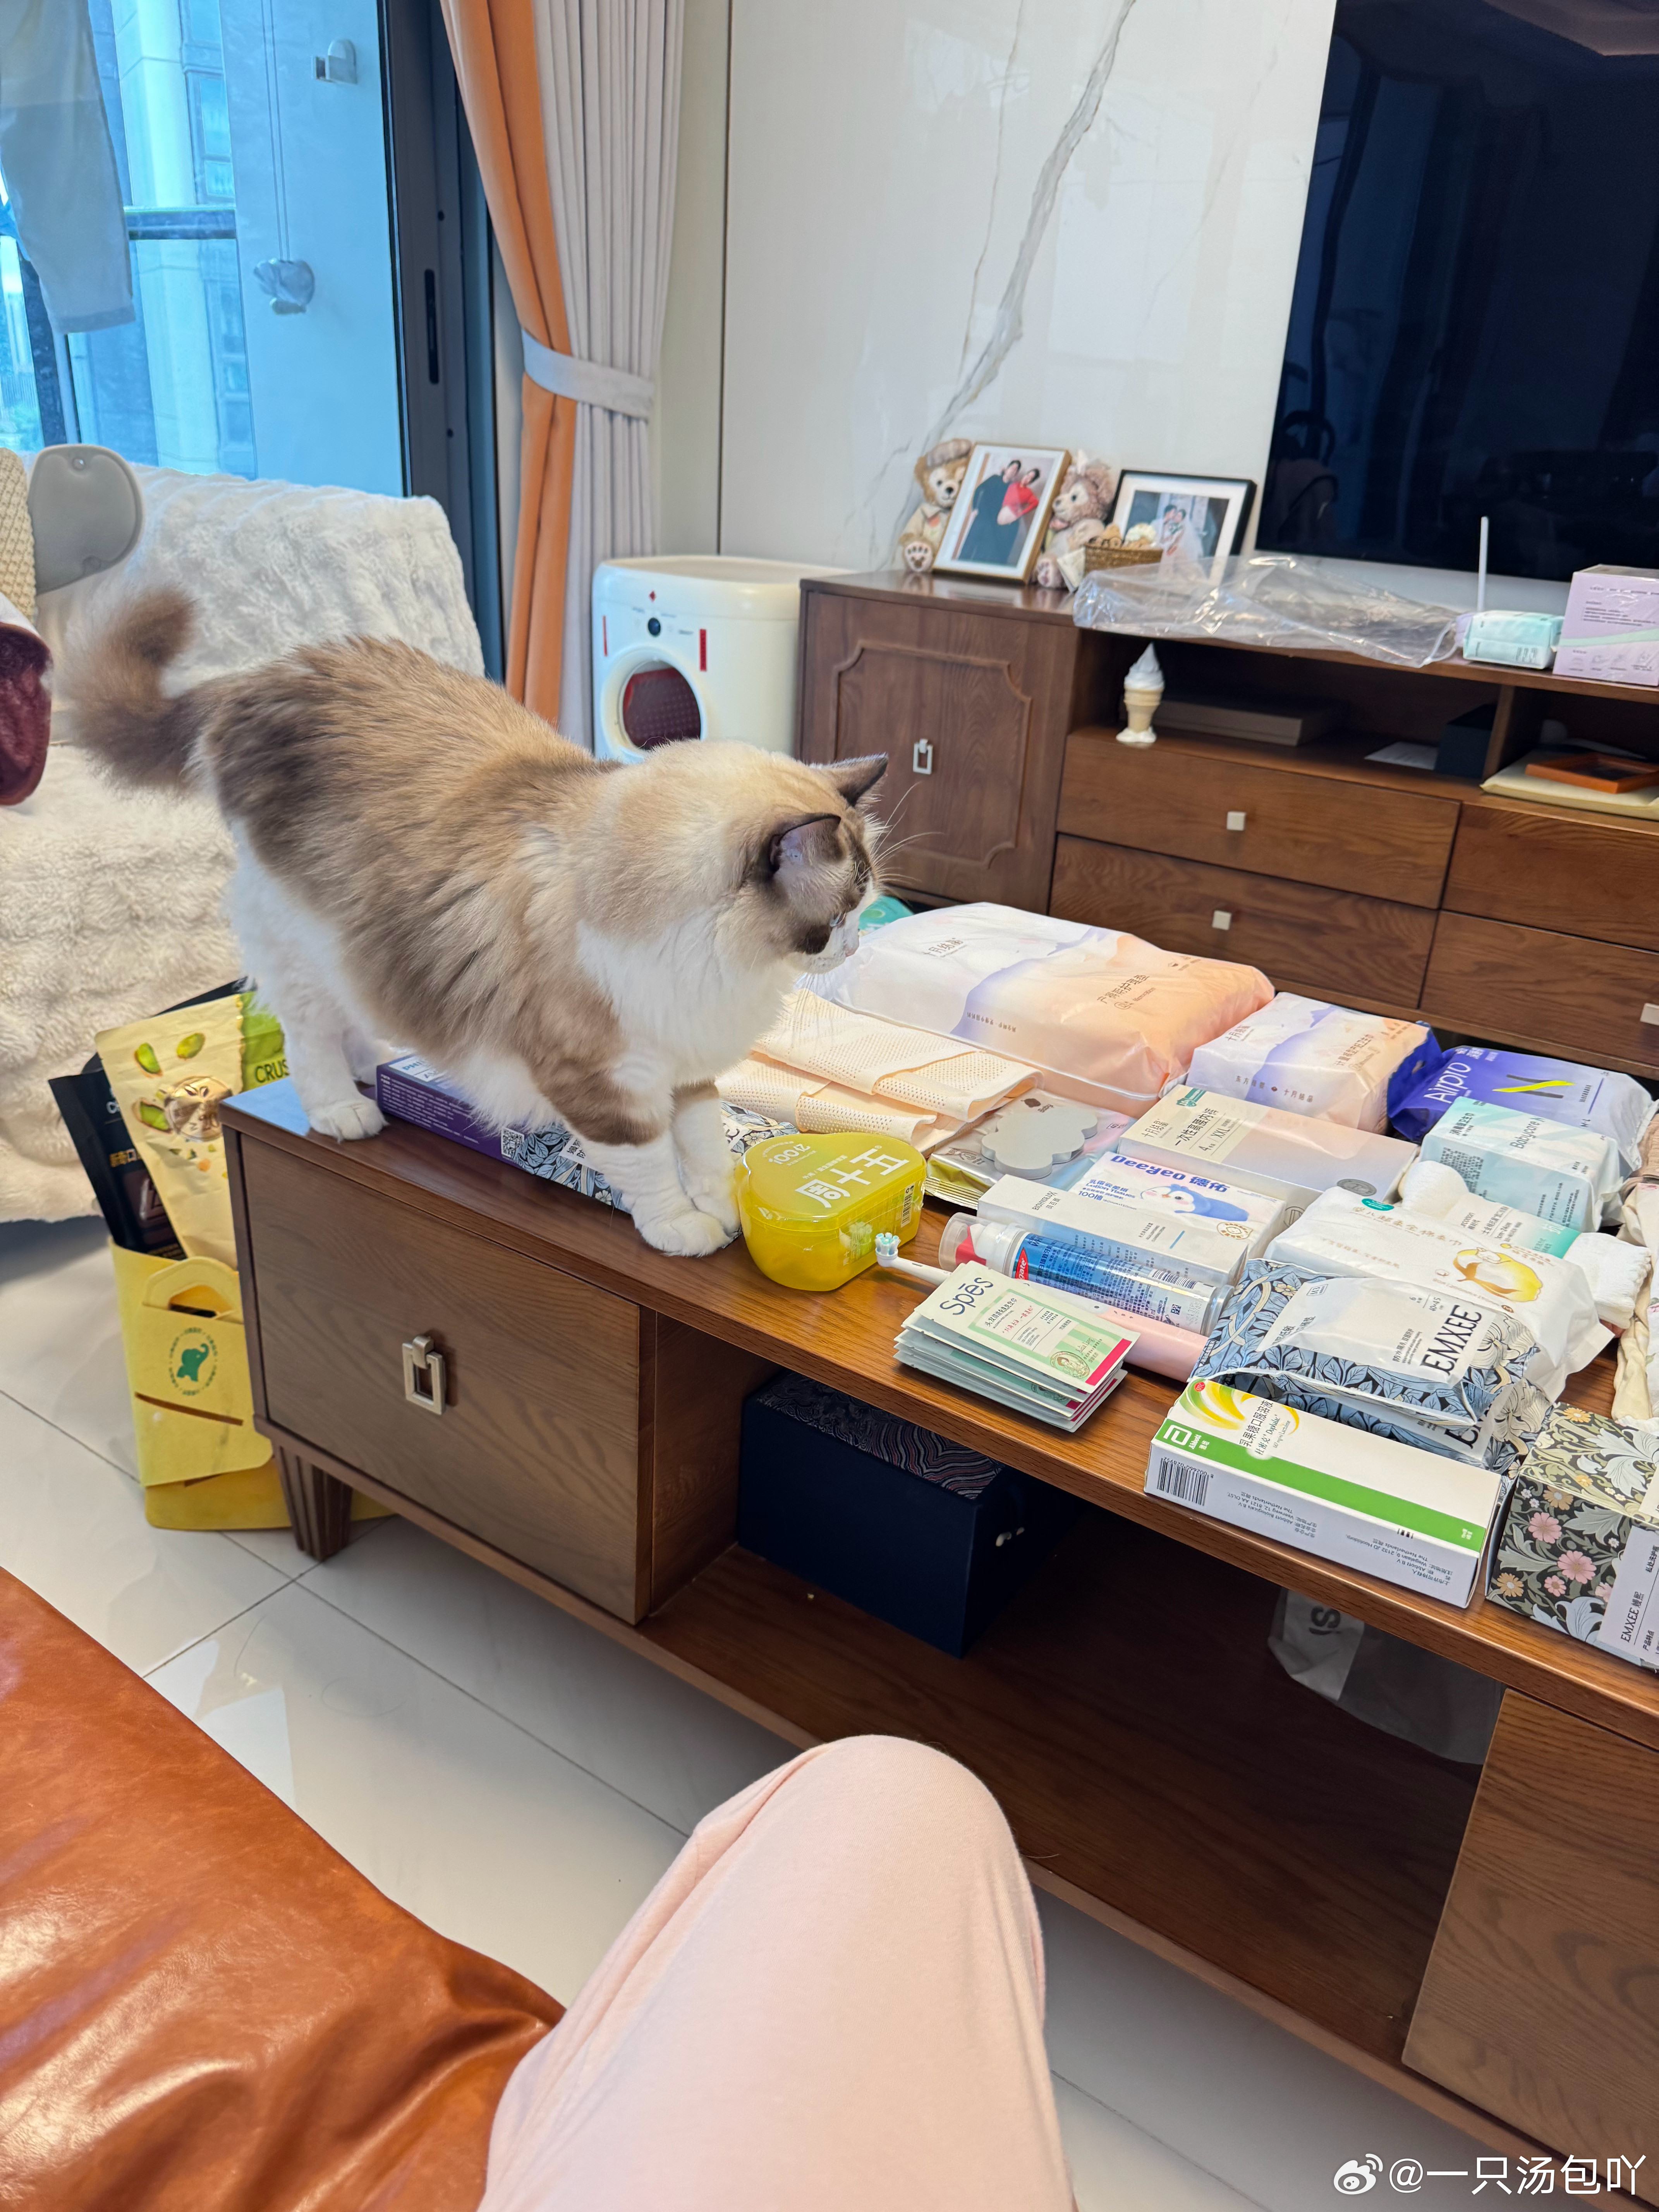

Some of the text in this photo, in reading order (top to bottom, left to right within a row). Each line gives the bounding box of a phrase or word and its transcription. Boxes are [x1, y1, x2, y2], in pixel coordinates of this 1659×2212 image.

[1423, 1062, 1472, 1105] Airpro
[1510, 1120, 1541, 1149] Babycare
[795, 1148, 910, 1208] 周十五
[1110, 1156, 1230, 1193] Deeyeo 德佑
[1420, 1304, 1482, 1376] EMXEE
[1188, 1434, 1202, 1450] Abbott
[1239, 1400, 1274, 1448] 乳果糖口服溶液
[1275, 1515, 1293, 1524] Abbott
[1406, 1561, 1425, 1572] Abbott
[1621, 1607, 1639, 1643] EMXEE
